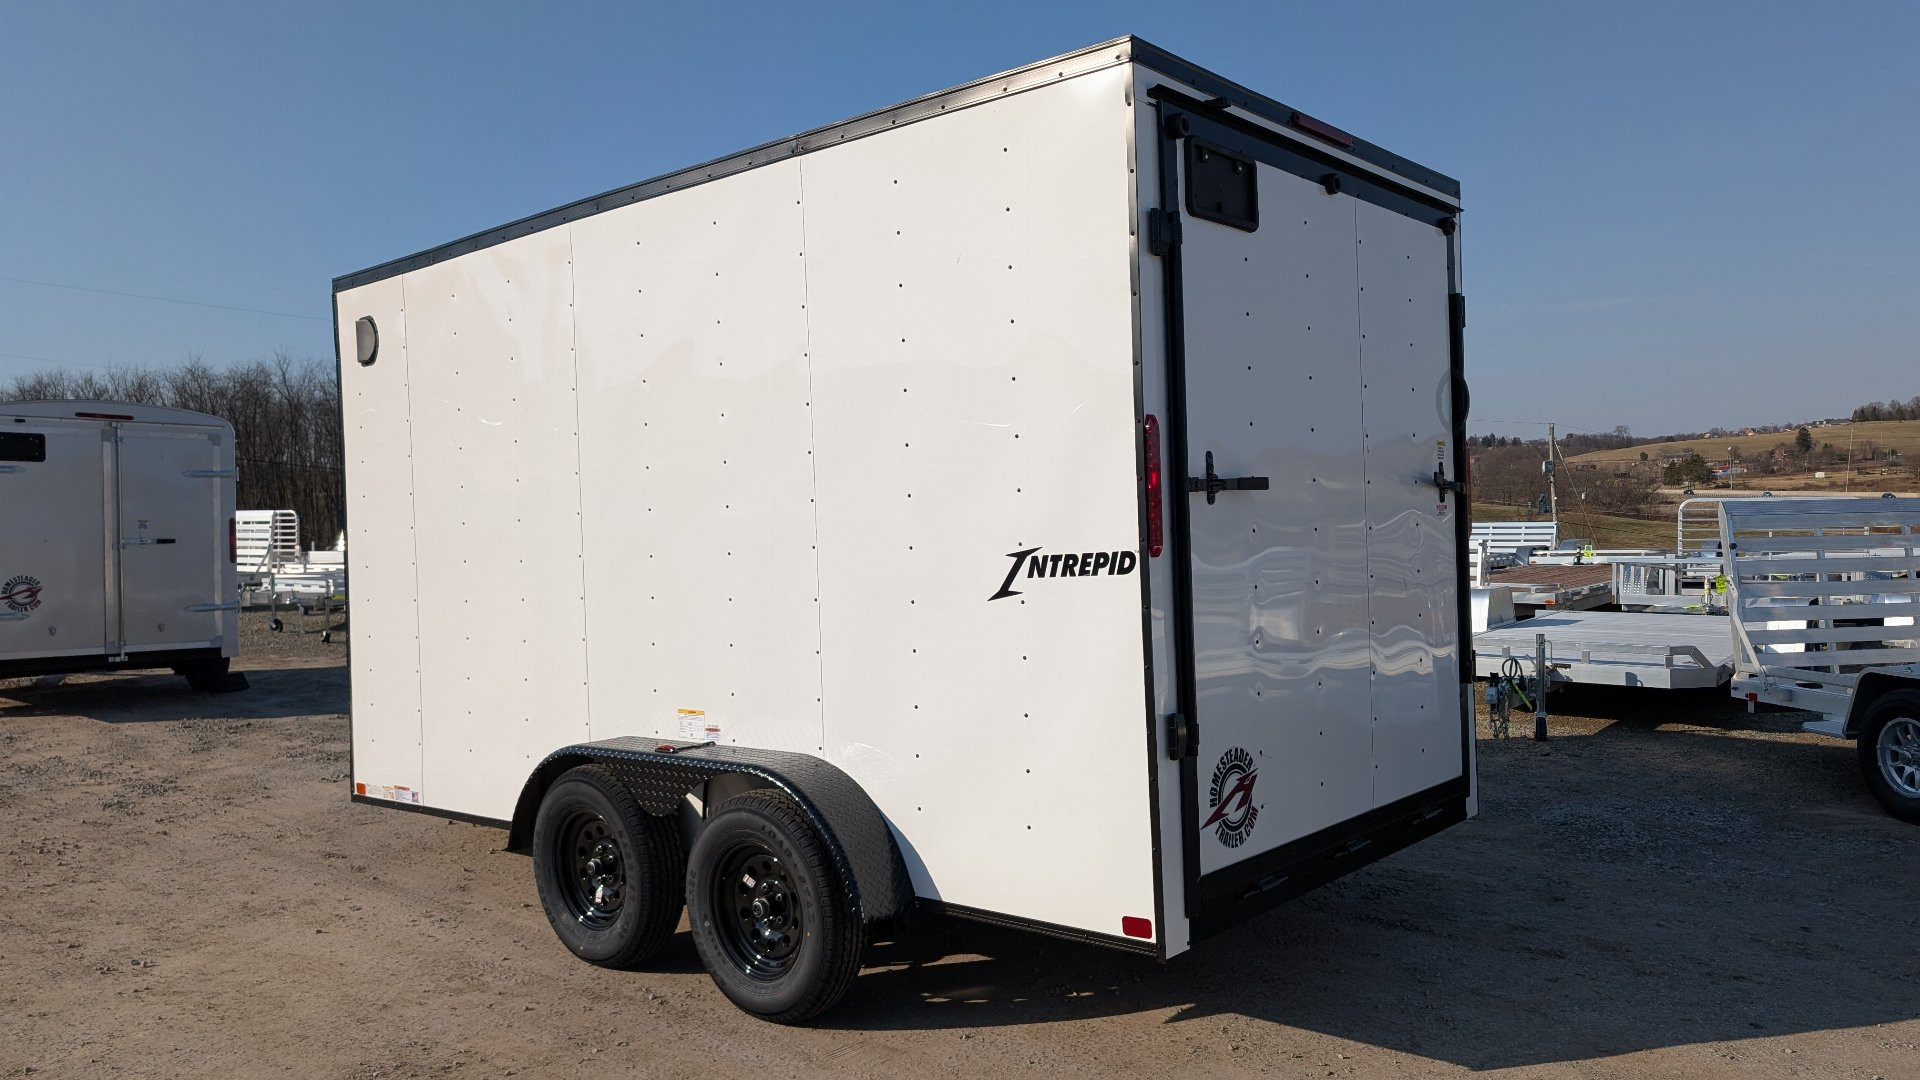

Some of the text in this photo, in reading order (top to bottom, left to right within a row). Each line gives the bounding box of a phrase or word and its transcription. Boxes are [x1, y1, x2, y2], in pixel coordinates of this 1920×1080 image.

[987, 546, 1137, 601] INTREPID
[1209, 747, 1254, 808] HOMESTEADER
[1215, 805, 1259, 848] TRAILER.COM
